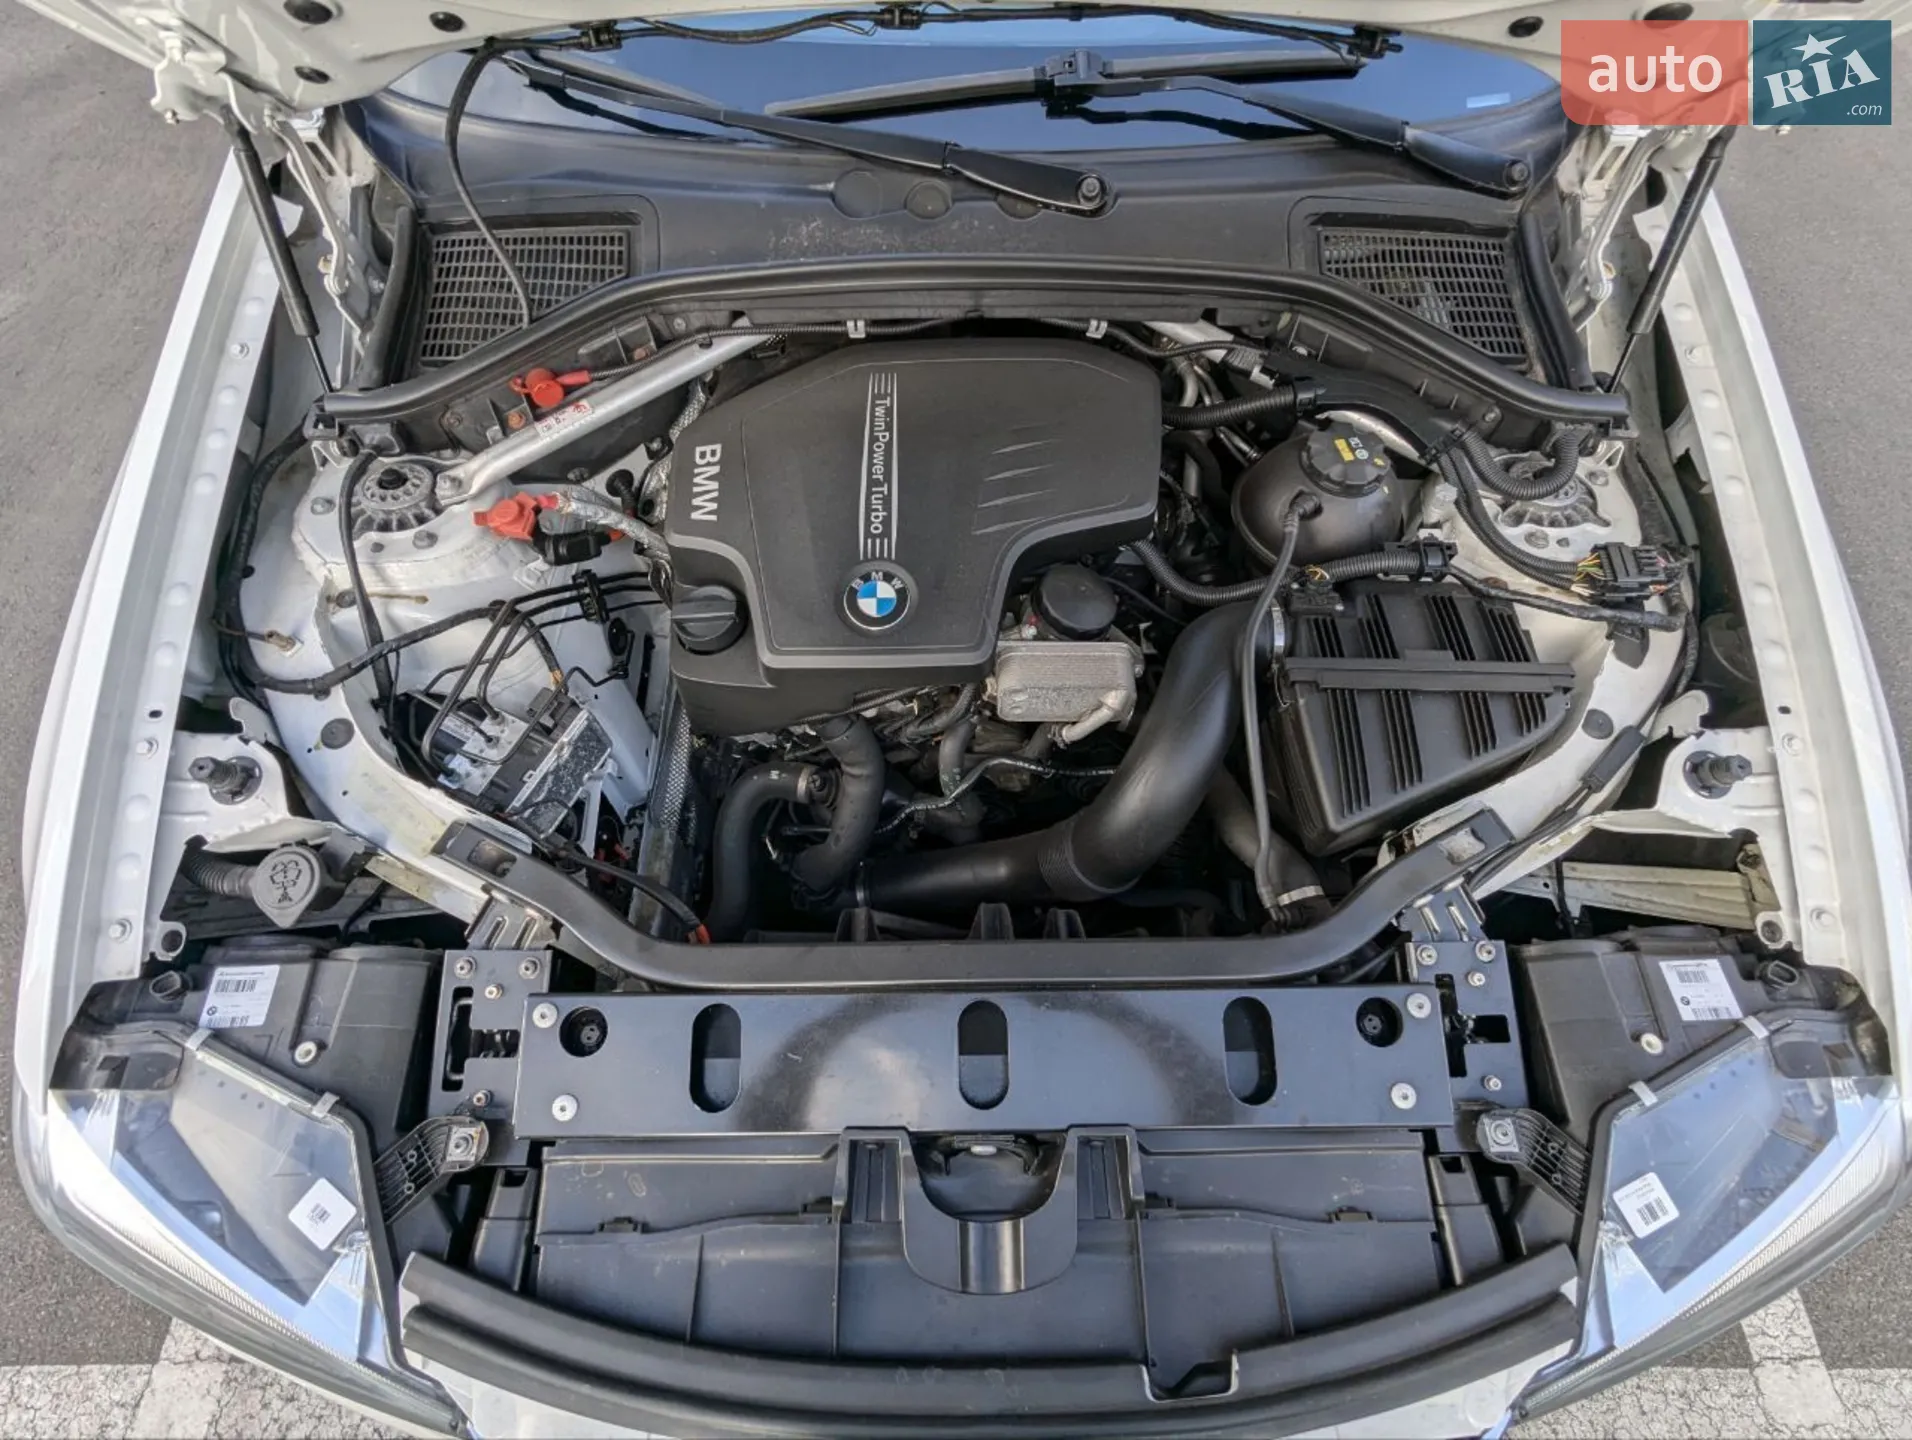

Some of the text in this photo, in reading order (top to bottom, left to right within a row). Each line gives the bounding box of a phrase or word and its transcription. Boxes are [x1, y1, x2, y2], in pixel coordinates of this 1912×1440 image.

[690, 443, 722, 522] BMW
[869, 396, 890, 534] TwinPower Turbo
[850, 571, 905, 591] BMW
